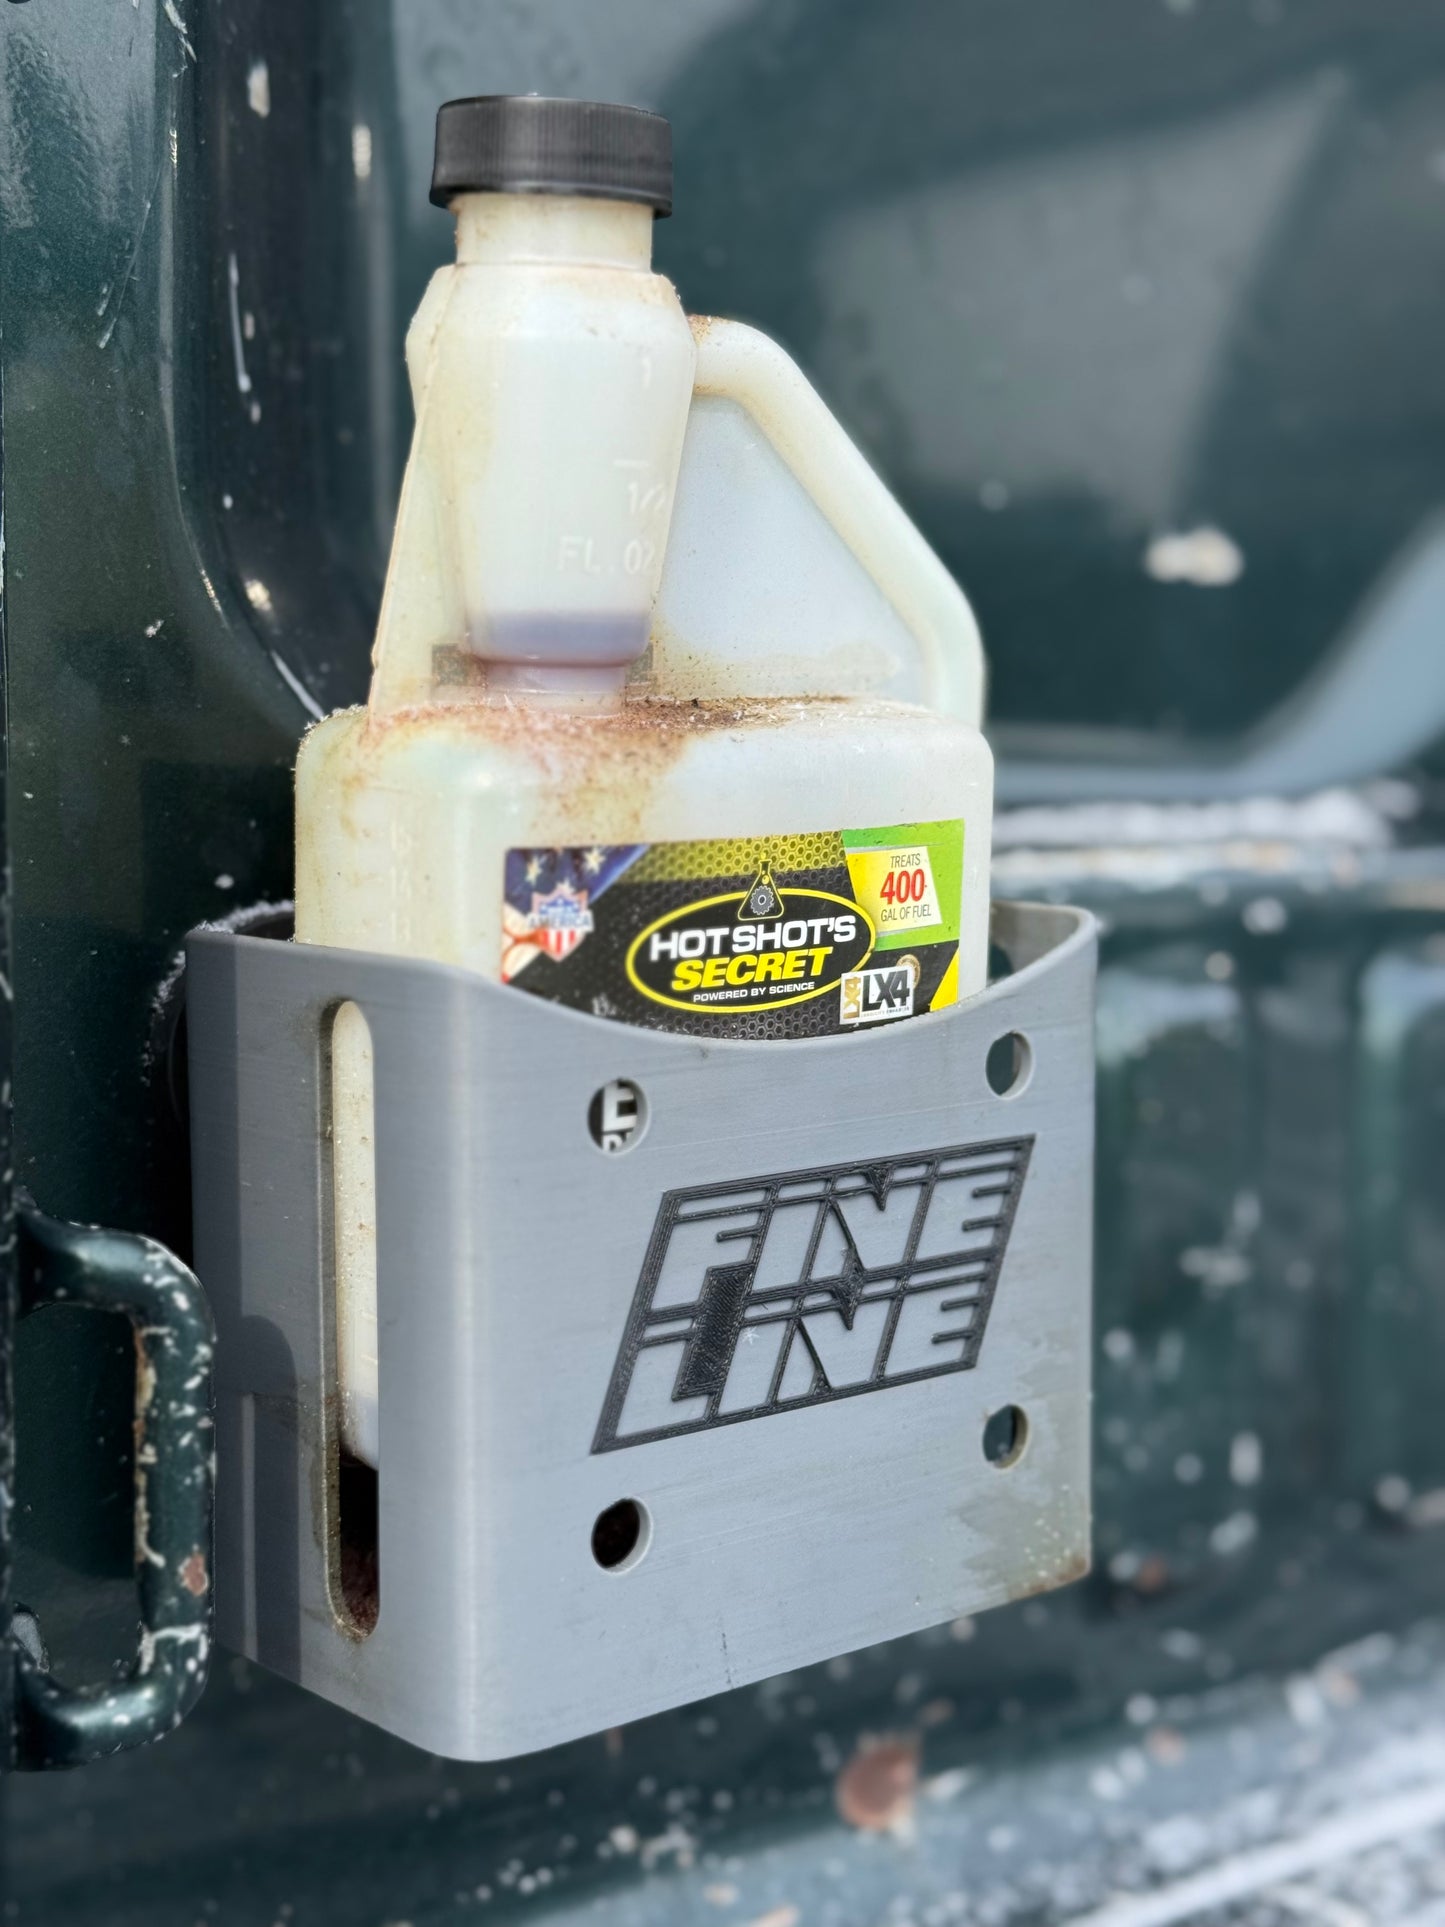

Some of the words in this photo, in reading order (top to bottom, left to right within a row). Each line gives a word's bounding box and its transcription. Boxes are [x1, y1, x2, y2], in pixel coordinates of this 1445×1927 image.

[890, 853, 921, 868] TREATS
[879, 868, 926, 905] 400
[880, 907, 898, 922] GAL
[899, 905, 912, 920] OF
[912, 903, 932, 919] FUEL
[649, 927, 730, 962] HOT
[731, 915, 857, 954] SHOT'S
[670, 946, 834, 993] SECRET
[692, 989, 748, 1004] POWERED
[750, 987, 766, 998] BY
[768, 981, 816, 996] SCIENCE
[861, 969, 911, 1013] LX4
